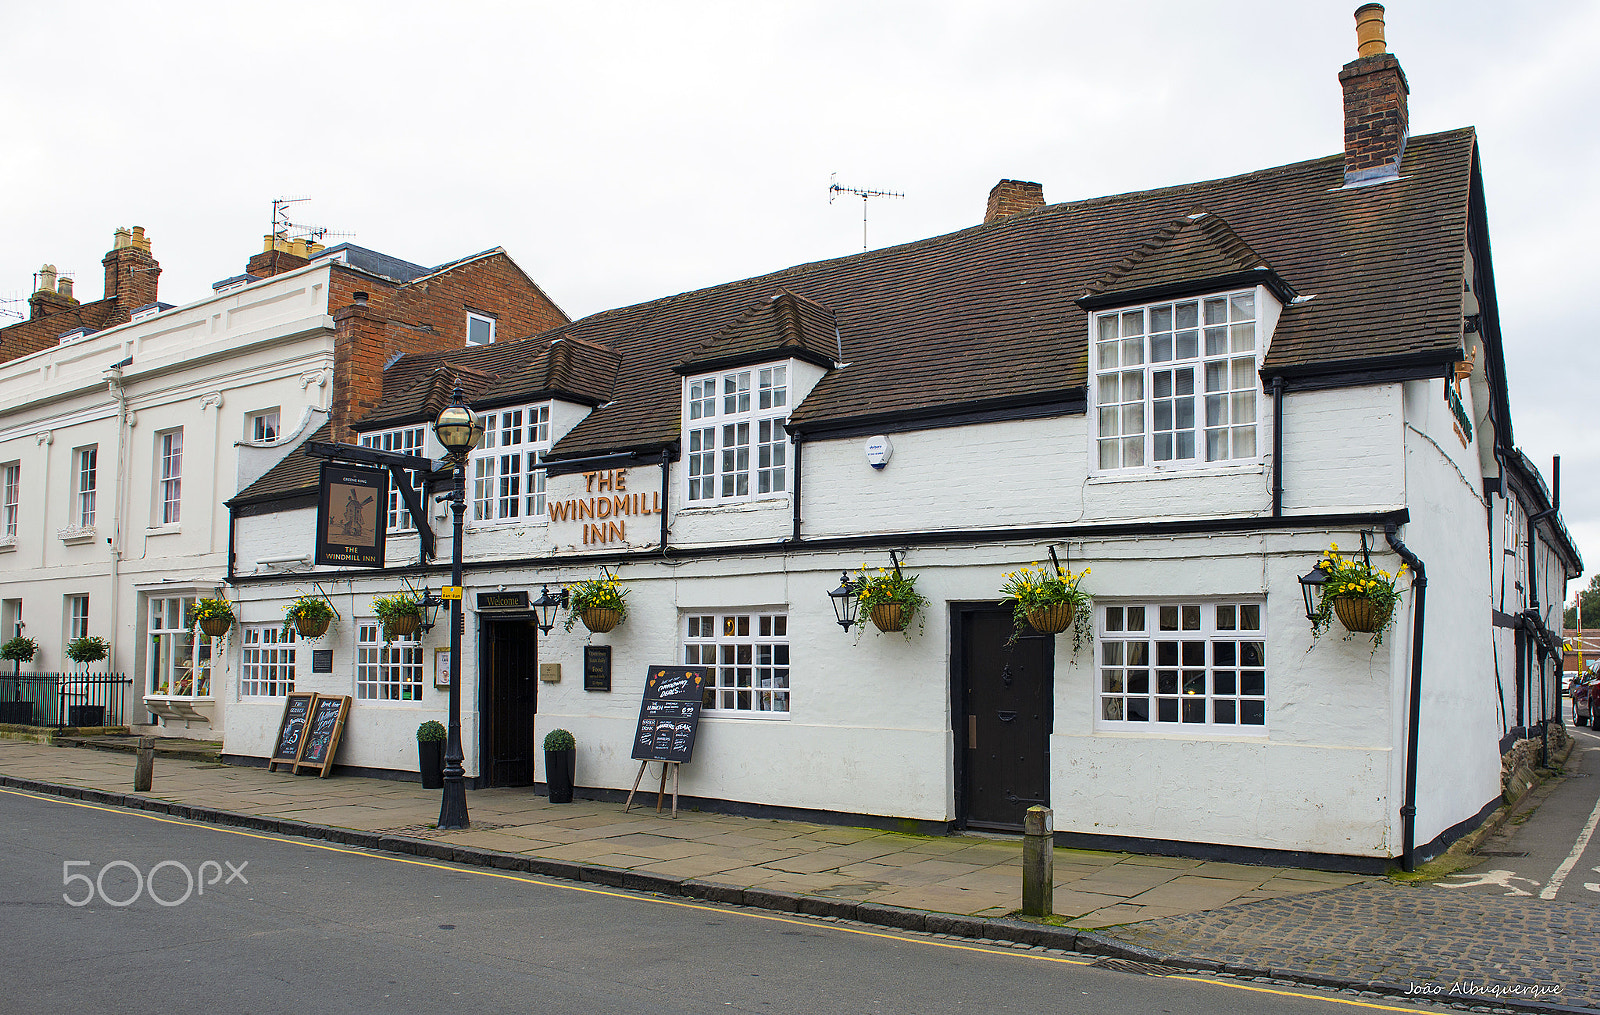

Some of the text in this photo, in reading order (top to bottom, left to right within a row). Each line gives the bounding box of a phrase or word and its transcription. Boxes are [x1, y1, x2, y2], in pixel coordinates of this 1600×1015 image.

[582, 468, 626, 492] THE
[547, 491, 662, 522] WINDMILL
[582, 520, 625, 545] INN
[325, 553, 360, 561] WINDMILL
[344, 546, 358, 554] THE
[486, 595, 519, 606] Welcome
